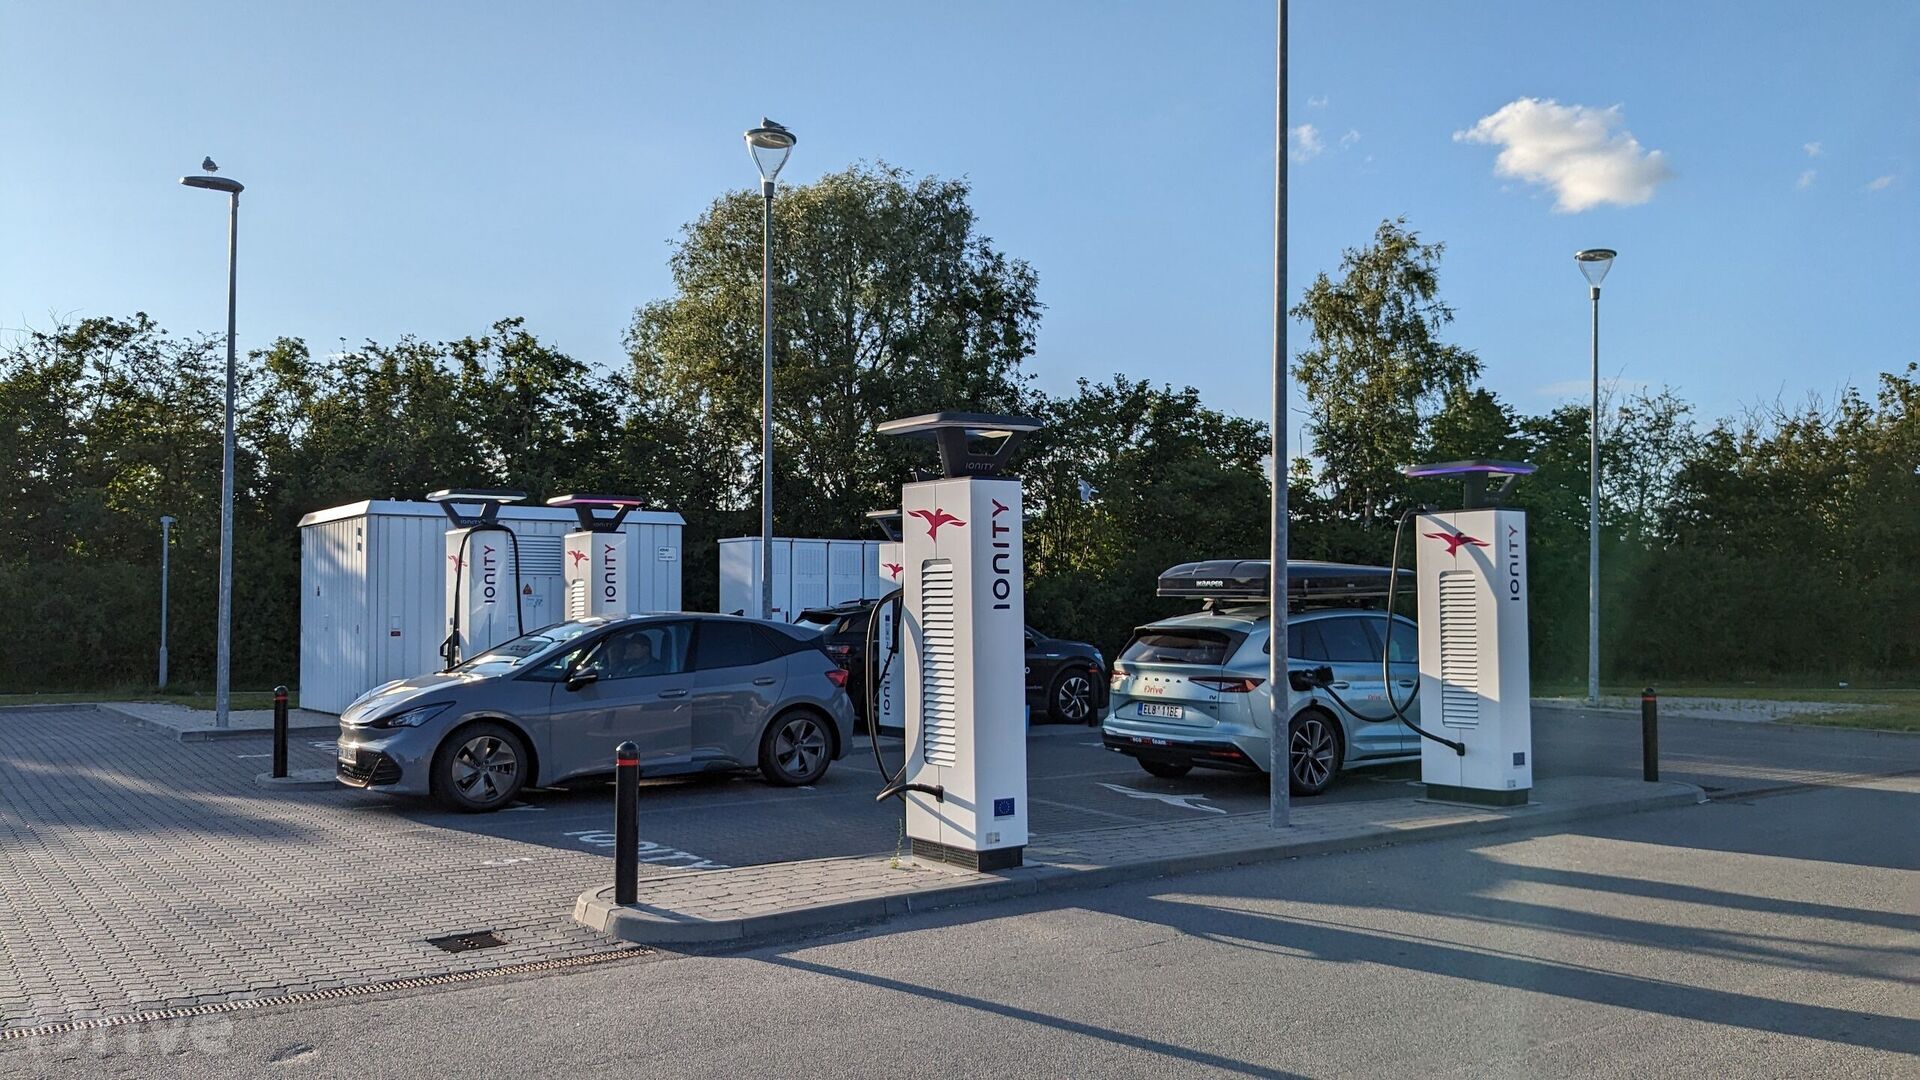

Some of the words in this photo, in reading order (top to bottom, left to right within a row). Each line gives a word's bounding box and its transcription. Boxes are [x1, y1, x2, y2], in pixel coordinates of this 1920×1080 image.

[965, 462, 995, 471] IONITY
[483, 544, 496, 604] IONITY
[604, 543, 617, 603] IONITY
[992, 498, 1011, 609] IONITY
[1509, 525, 1519, 601] IONITY
